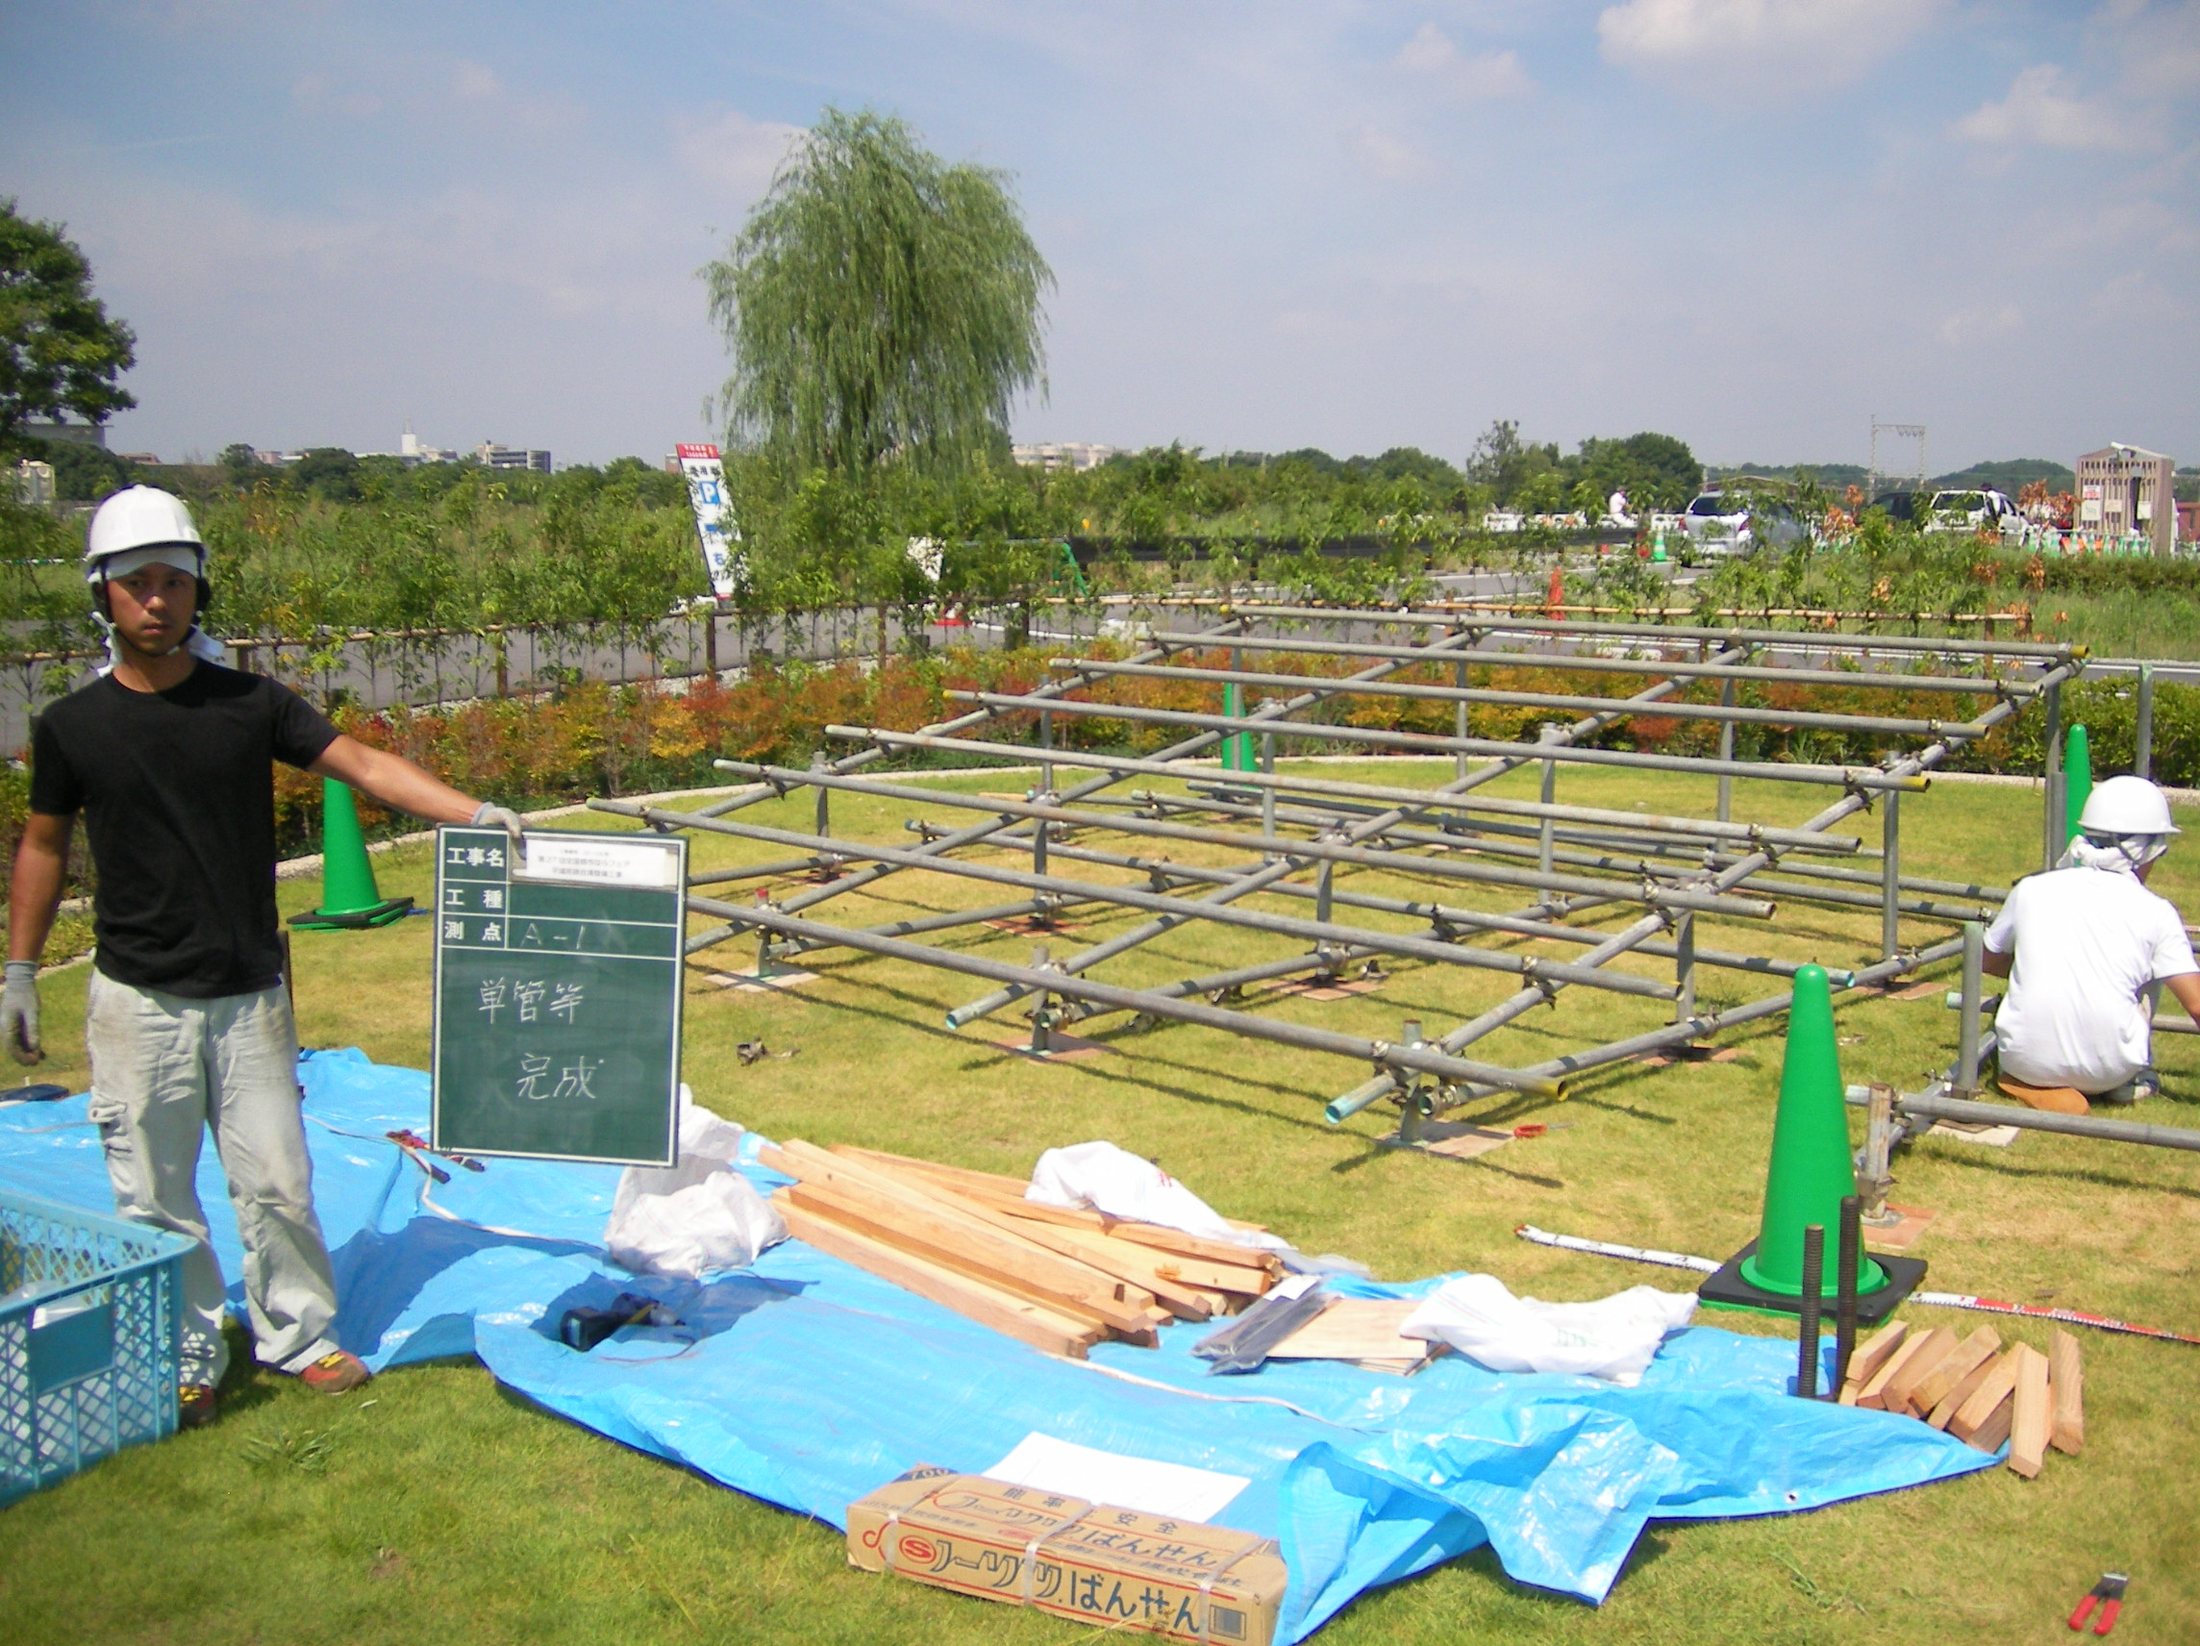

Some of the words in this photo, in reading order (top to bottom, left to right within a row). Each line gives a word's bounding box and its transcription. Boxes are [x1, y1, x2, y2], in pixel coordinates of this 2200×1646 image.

[446, 846, 504, 867] 工事名
[520, 922, 586, 950] A-1
[479, 976, 584, 1024] 単管等
[517, 1053, 605, 1100] 完成
